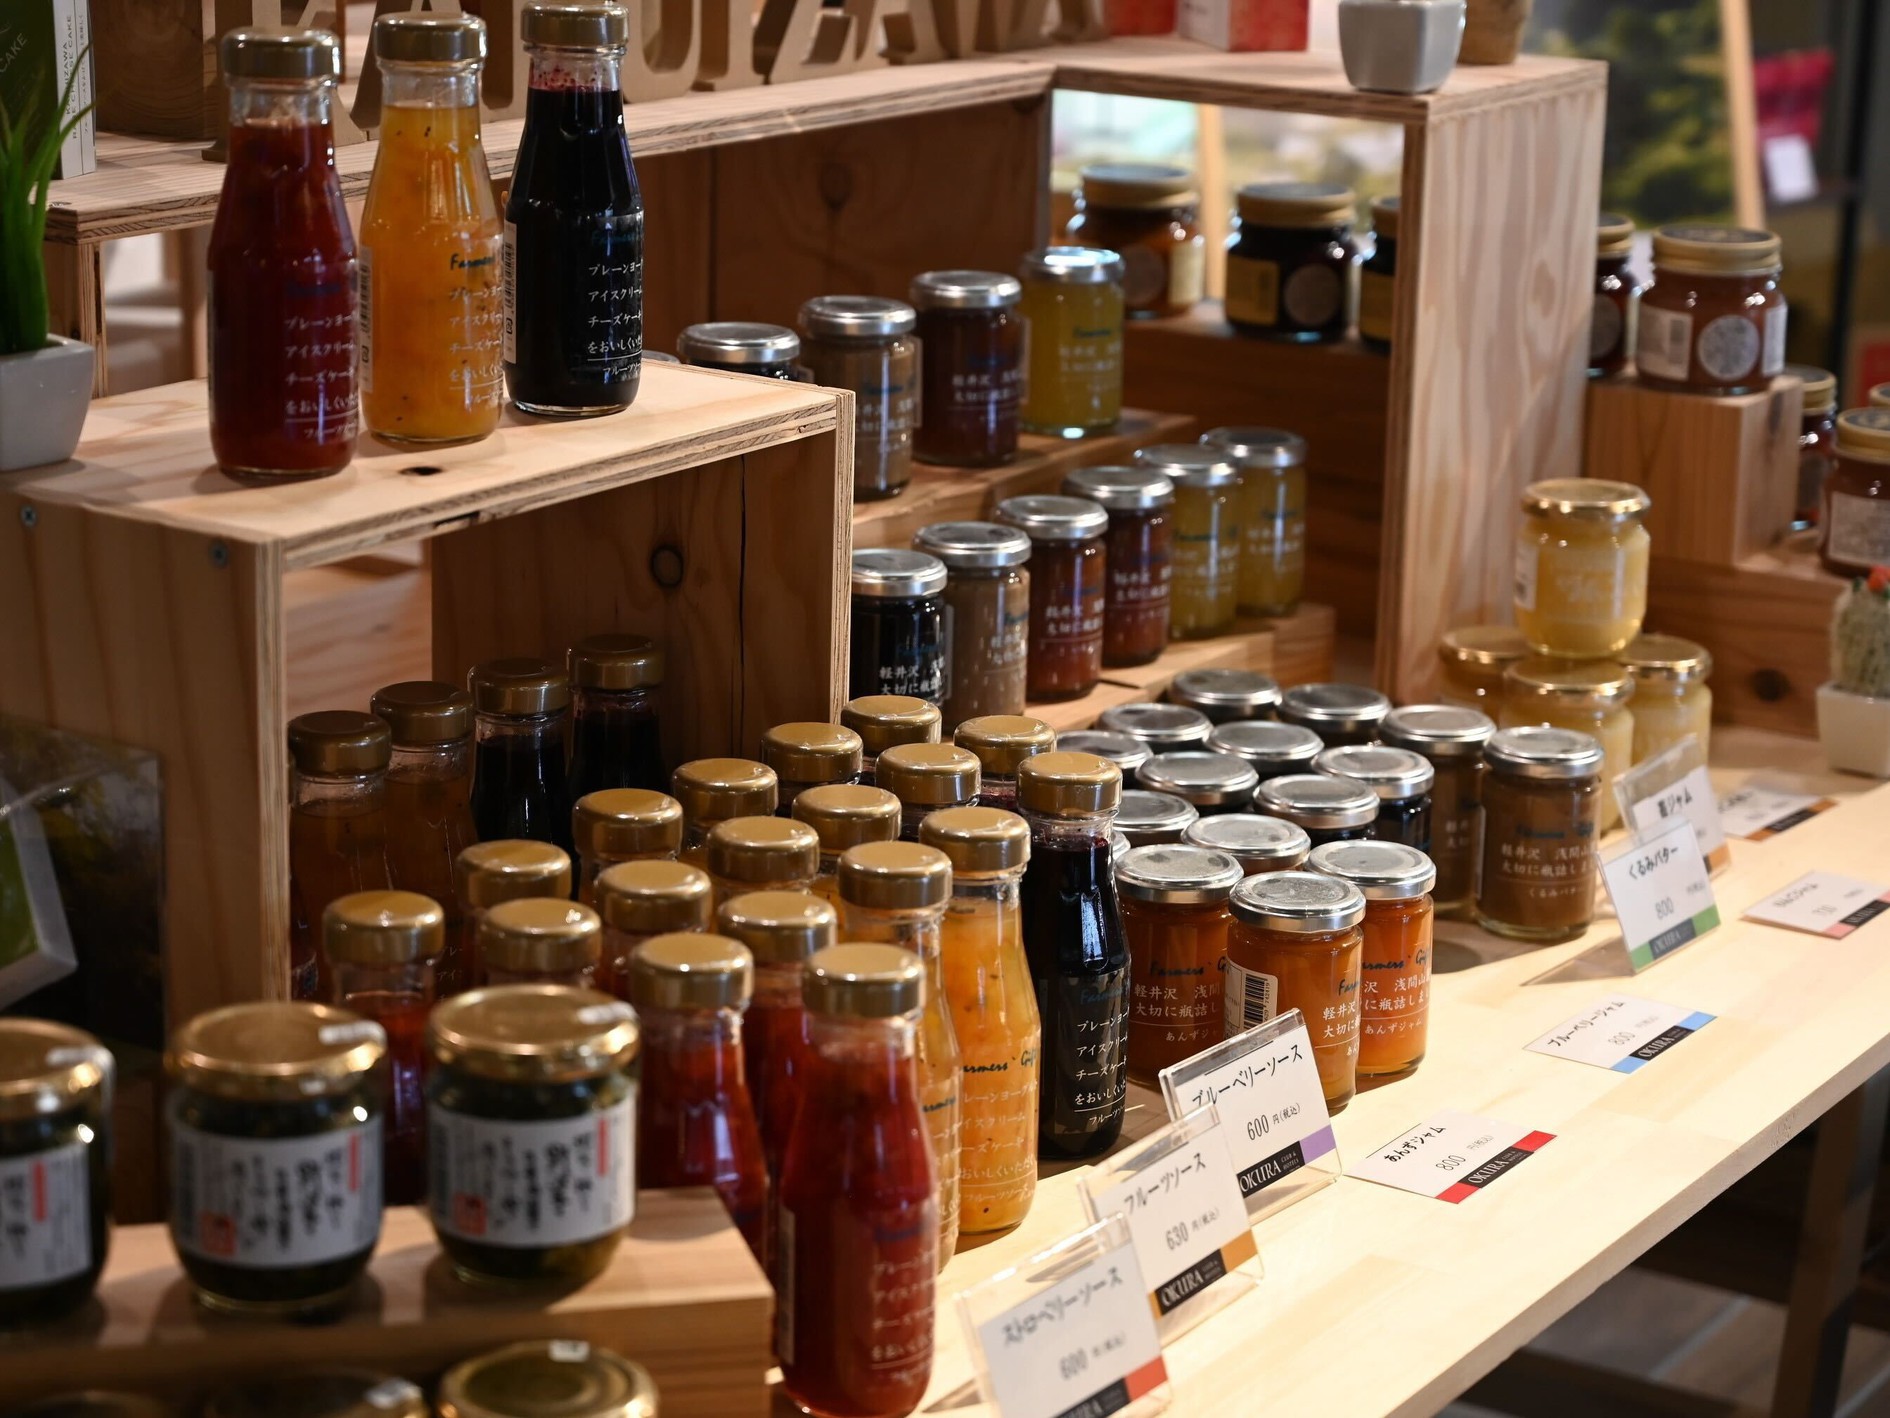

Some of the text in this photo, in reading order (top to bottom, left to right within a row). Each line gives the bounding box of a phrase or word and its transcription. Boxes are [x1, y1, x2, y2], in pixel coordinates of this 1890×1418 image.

[62, 42, 71, 115] KUIZAWA
[1628, 846, 1680, 881] くるみバター
[1654, 896, 1676, 922] 800
[1133, 983, 1179, 1000] 軽井沢
[1322, 1000, 1357, 1021] 軽井沢
[1547, 999, 1626, 1047] ブルーベリージャム
[1607, 1031, 1637, 1047] 800
[1637, 1036, 1676, 1059] OKURA
[1192, 1043, 1304, 1107] ブルーベリーソース
[1246, 1113, 1271, 1142] 600
[1383, 1125, 1447, 1164] あんずジャム
[1238, 1158, 1283, 1194] OKURA
[1435, 1154, 1467, 1172] 800
[1467, 1158, 1510, 1185] OKURA
[1123, 1152, 1207, 1216] フルーツソース
[1164, 1220, 1190, 1251] 630
[1160, 1269, 1205, 1308] OKURA
